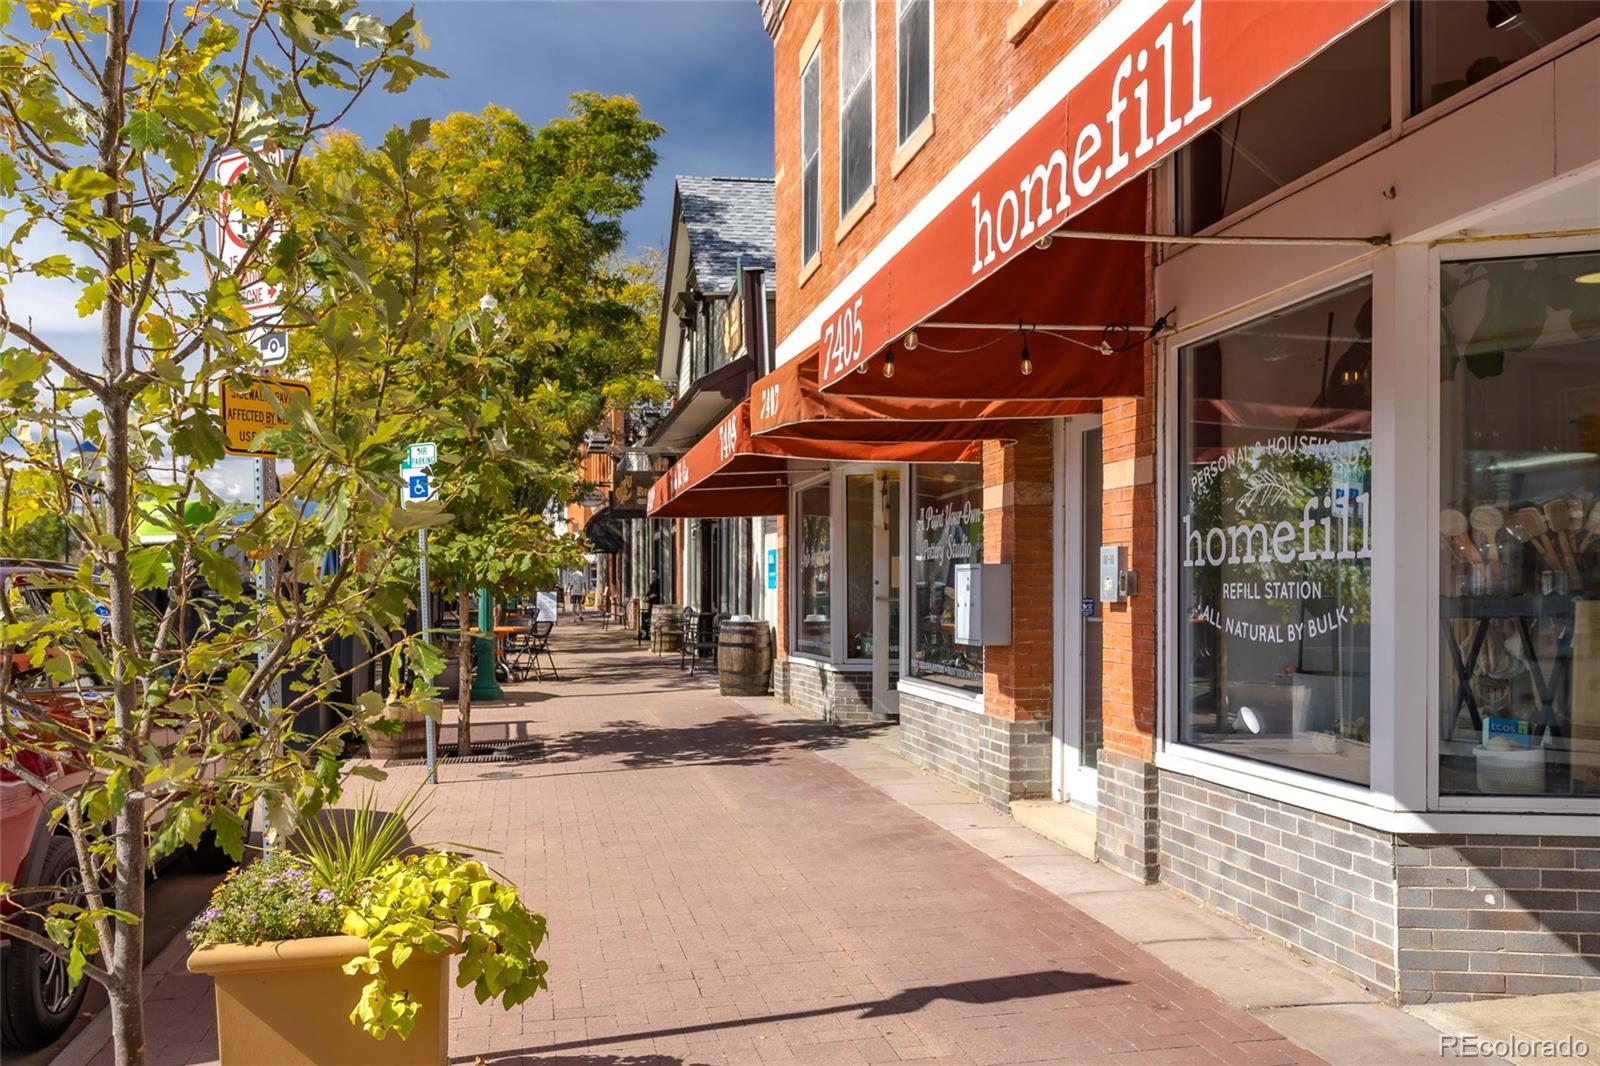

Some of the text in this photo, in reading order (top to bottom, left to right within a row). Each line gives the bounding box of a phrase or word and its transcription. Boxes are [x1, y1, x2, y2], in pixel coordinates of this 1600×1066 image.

[971, 0, 1212, 275] homefill
[823, 295, 863, 381] 7405
[228, 408, 263, 423] AFFECTED
[265, 411, 275, 424] BY
[760, 384, 780, 420] 7407
[239, 430, 257, 442] USE
[412, 456, 435, 466] PARKING
[1191, 447, 1251, 492] PERSONAL
[1267, 435, 1359, 465] HOUSEHOLD
[1182, 492, 1372, 567] homefill
[946, 534, 971, 560] Studio
[1222, 581, 1322, 600] REFILL STATION
[1203, 604, 1349, 643] ALL NATURAL BY BULK
[1490, 722, 1516, 734] ECOS
